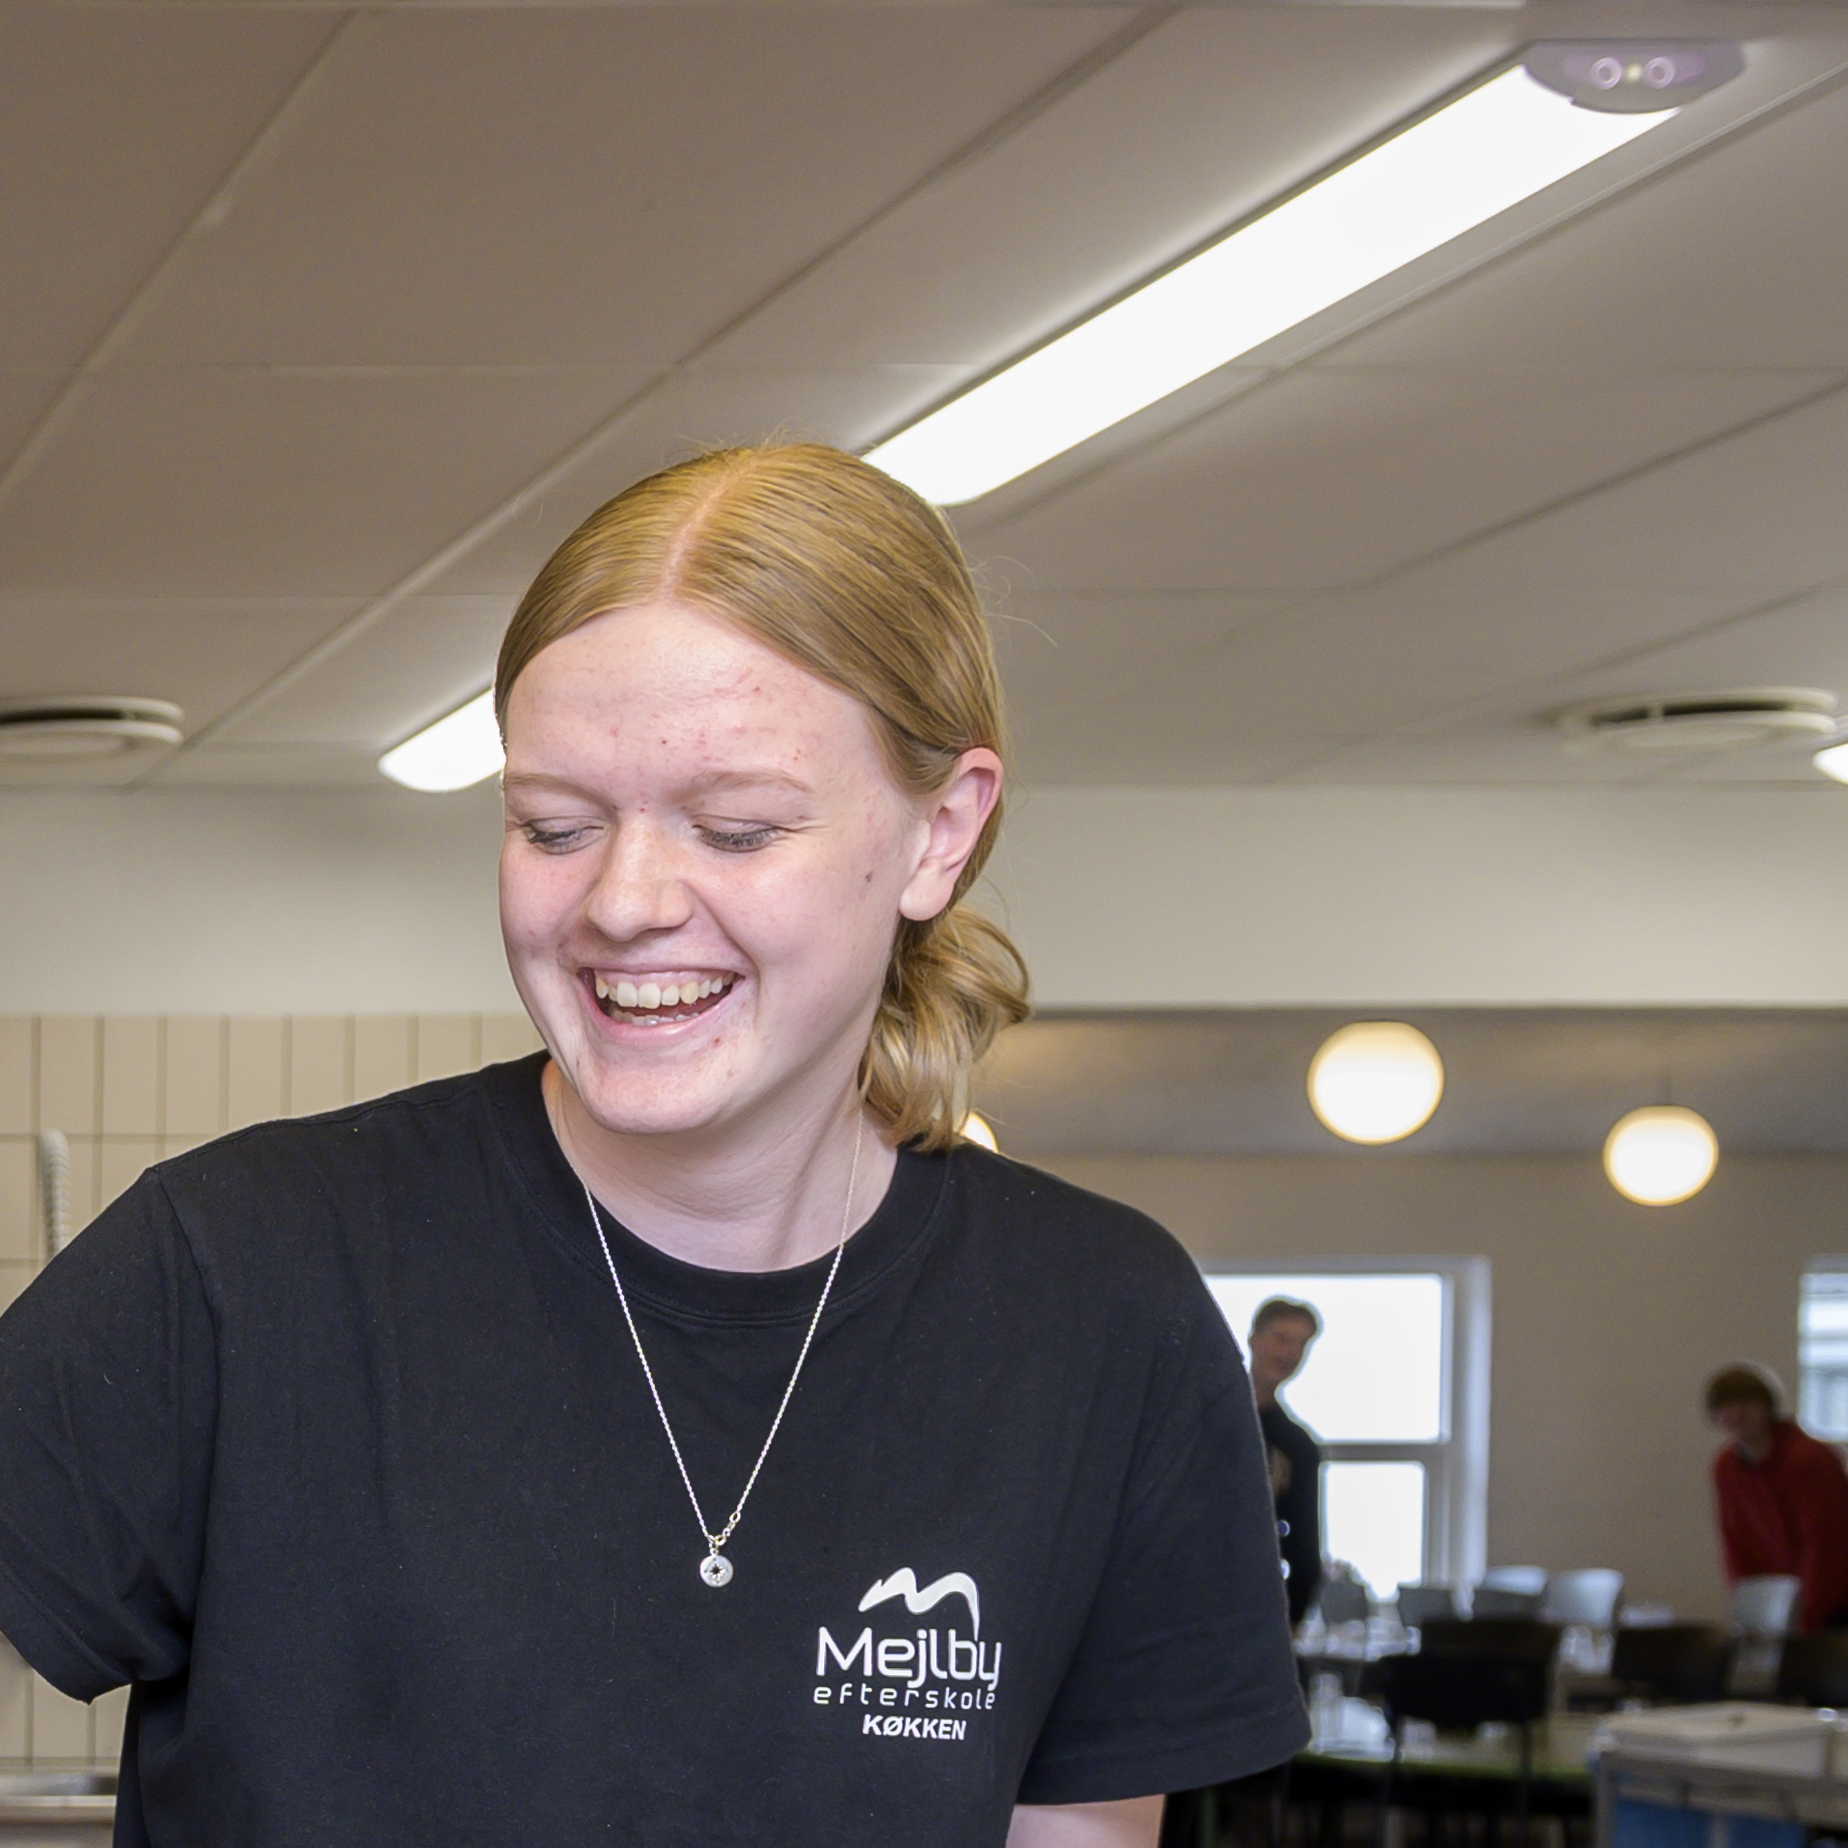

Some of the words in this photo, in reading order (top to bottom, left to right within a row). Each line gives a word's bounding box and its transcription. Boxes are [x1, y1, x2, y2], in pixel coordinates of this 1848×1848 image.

[815, 1625, 1003, 1692] Mejlby
[812, 1682, 997, 1710] efterskole
[861, 1713, 969, 1741] KØKKEN
